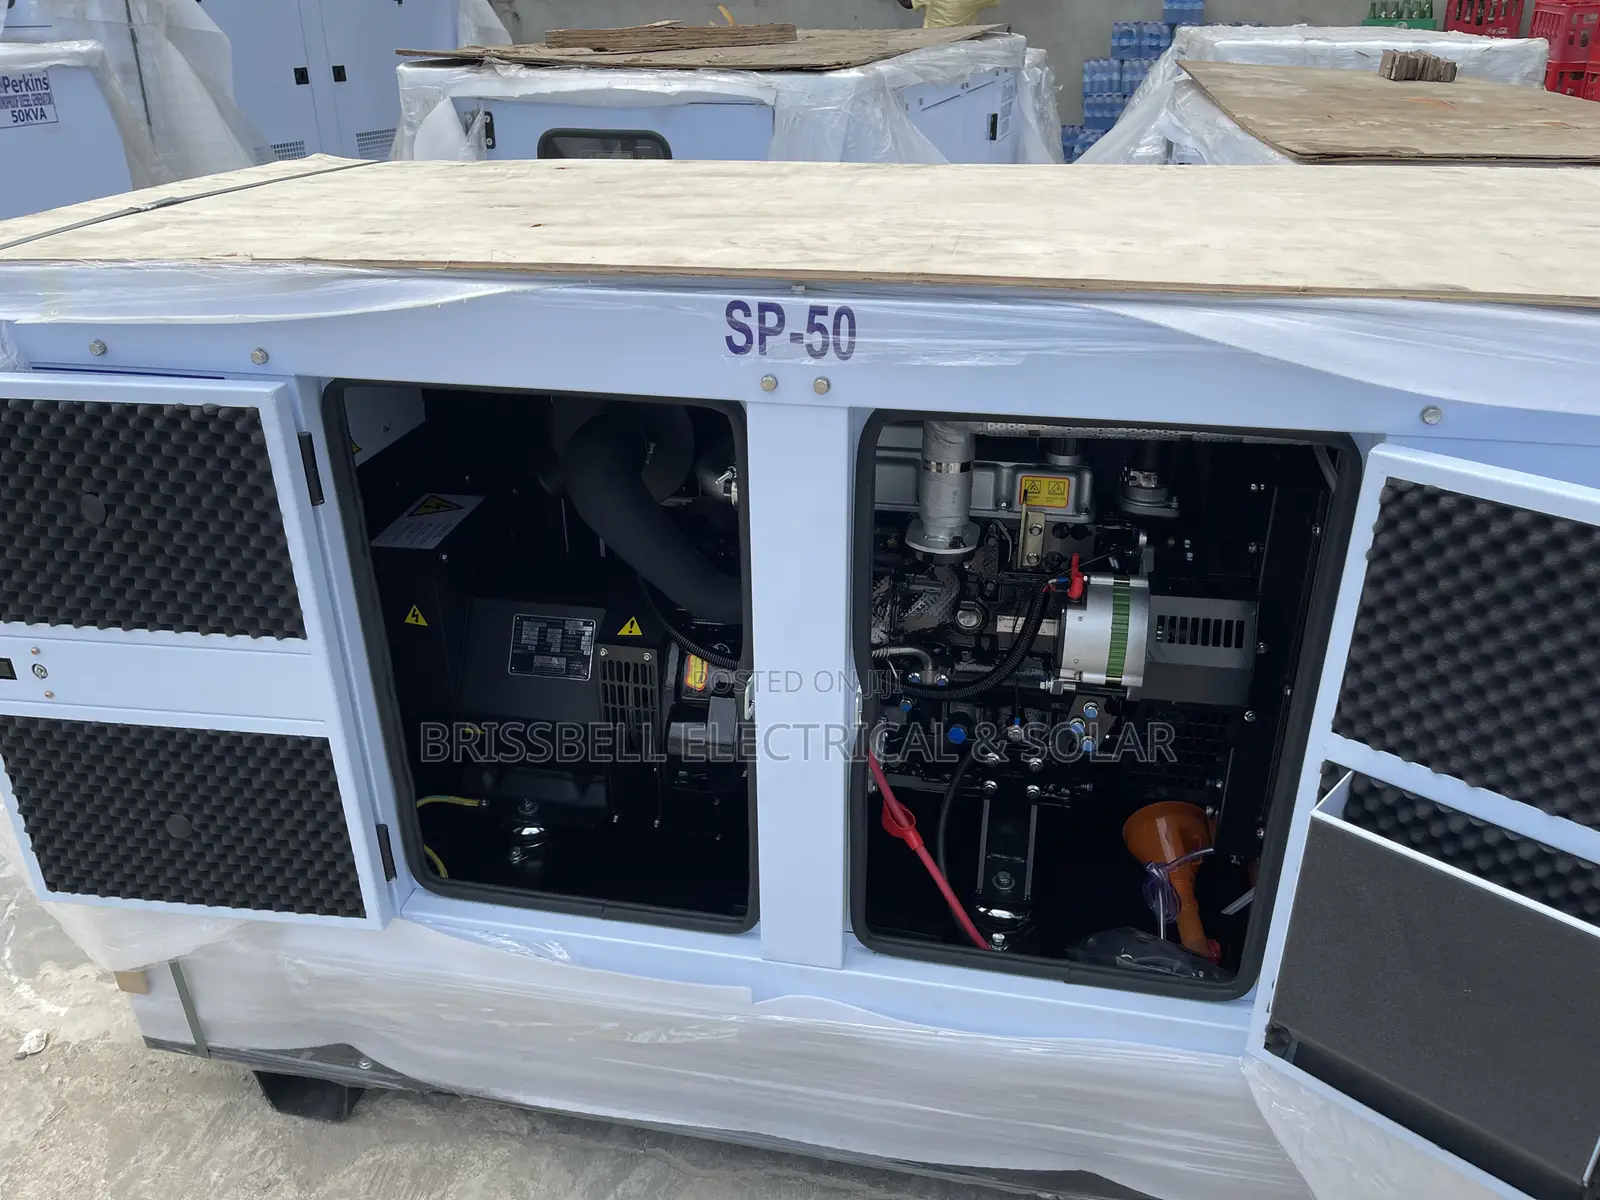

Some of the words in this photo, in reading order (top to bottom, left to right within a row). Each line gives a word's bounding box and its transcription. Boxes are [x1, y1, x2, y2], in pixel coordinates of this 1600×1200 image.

[2, 73, 49, 93] Perkins
[11, 107, 48, 123] 50KVA
[725, 300, 856, 360] SP-50
